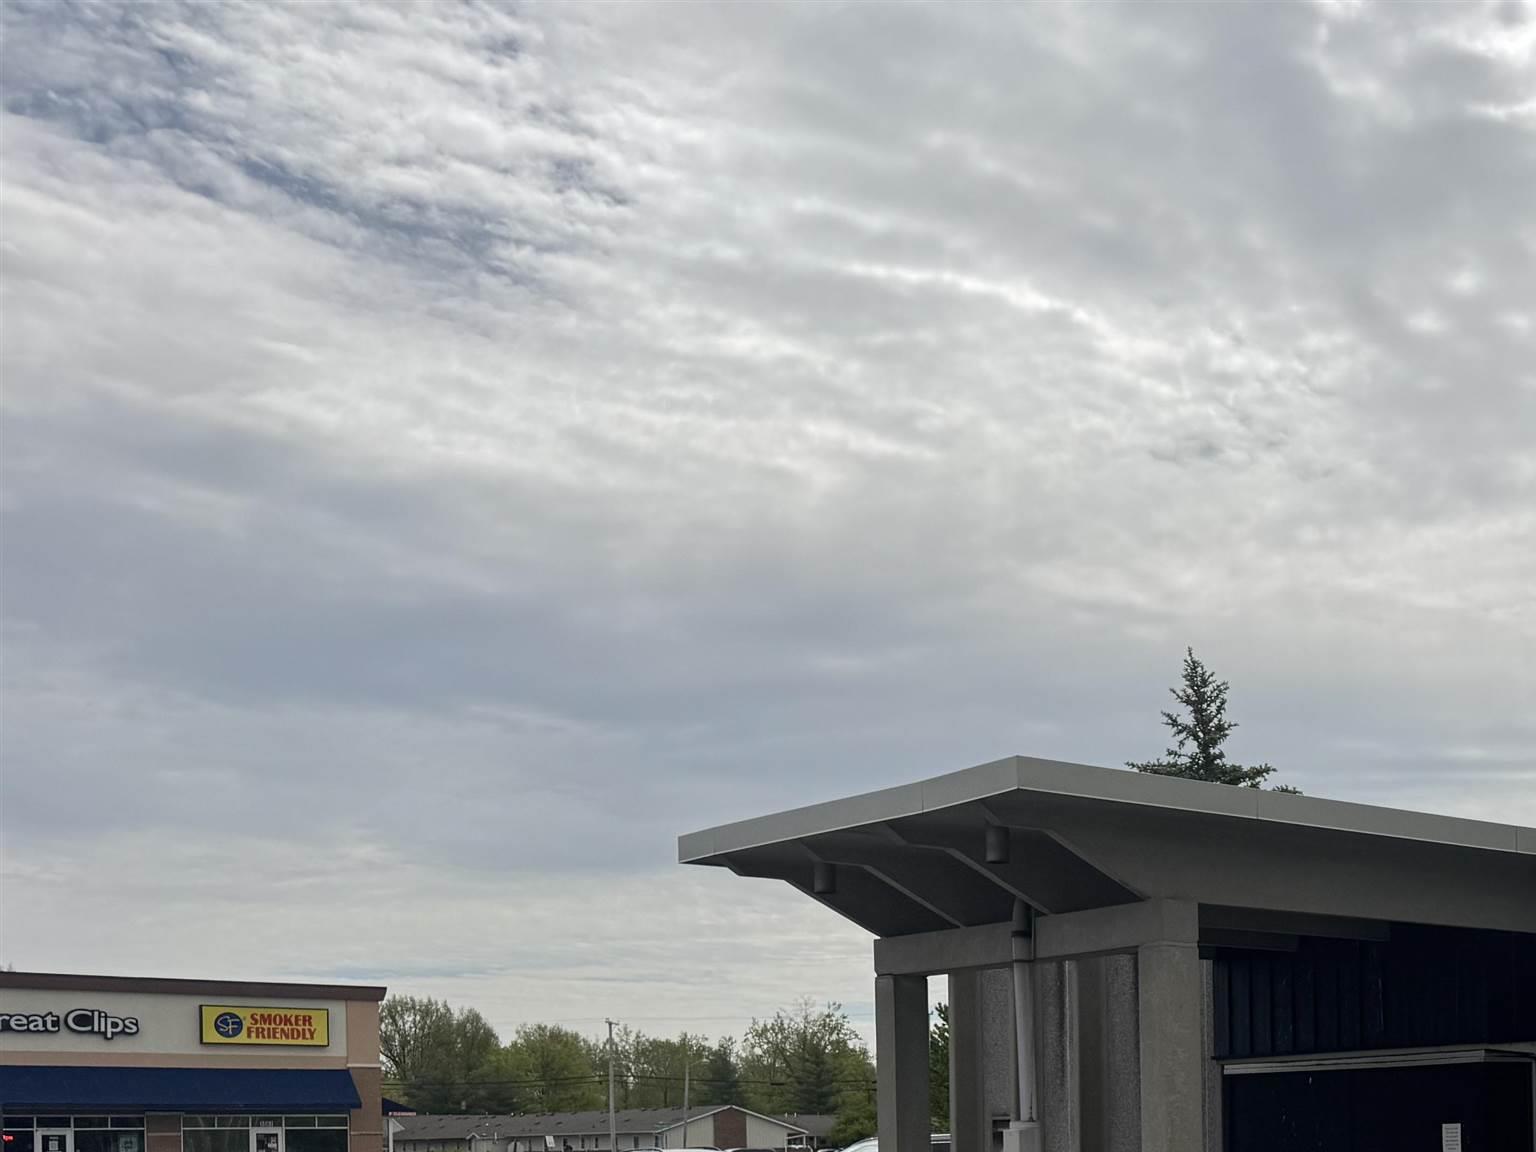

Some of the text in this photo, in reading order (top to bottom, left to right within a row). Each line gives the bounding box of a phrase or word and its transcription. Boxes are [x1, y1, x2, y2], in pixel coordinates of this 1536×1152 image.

[0, 1009, 138, 1039] reat Clips
[216, 1015, 241, 1035] SF
[250, 1012, 313, 1027] SMOKER
[246, 1026, 317, 1040] FRIENDLY
